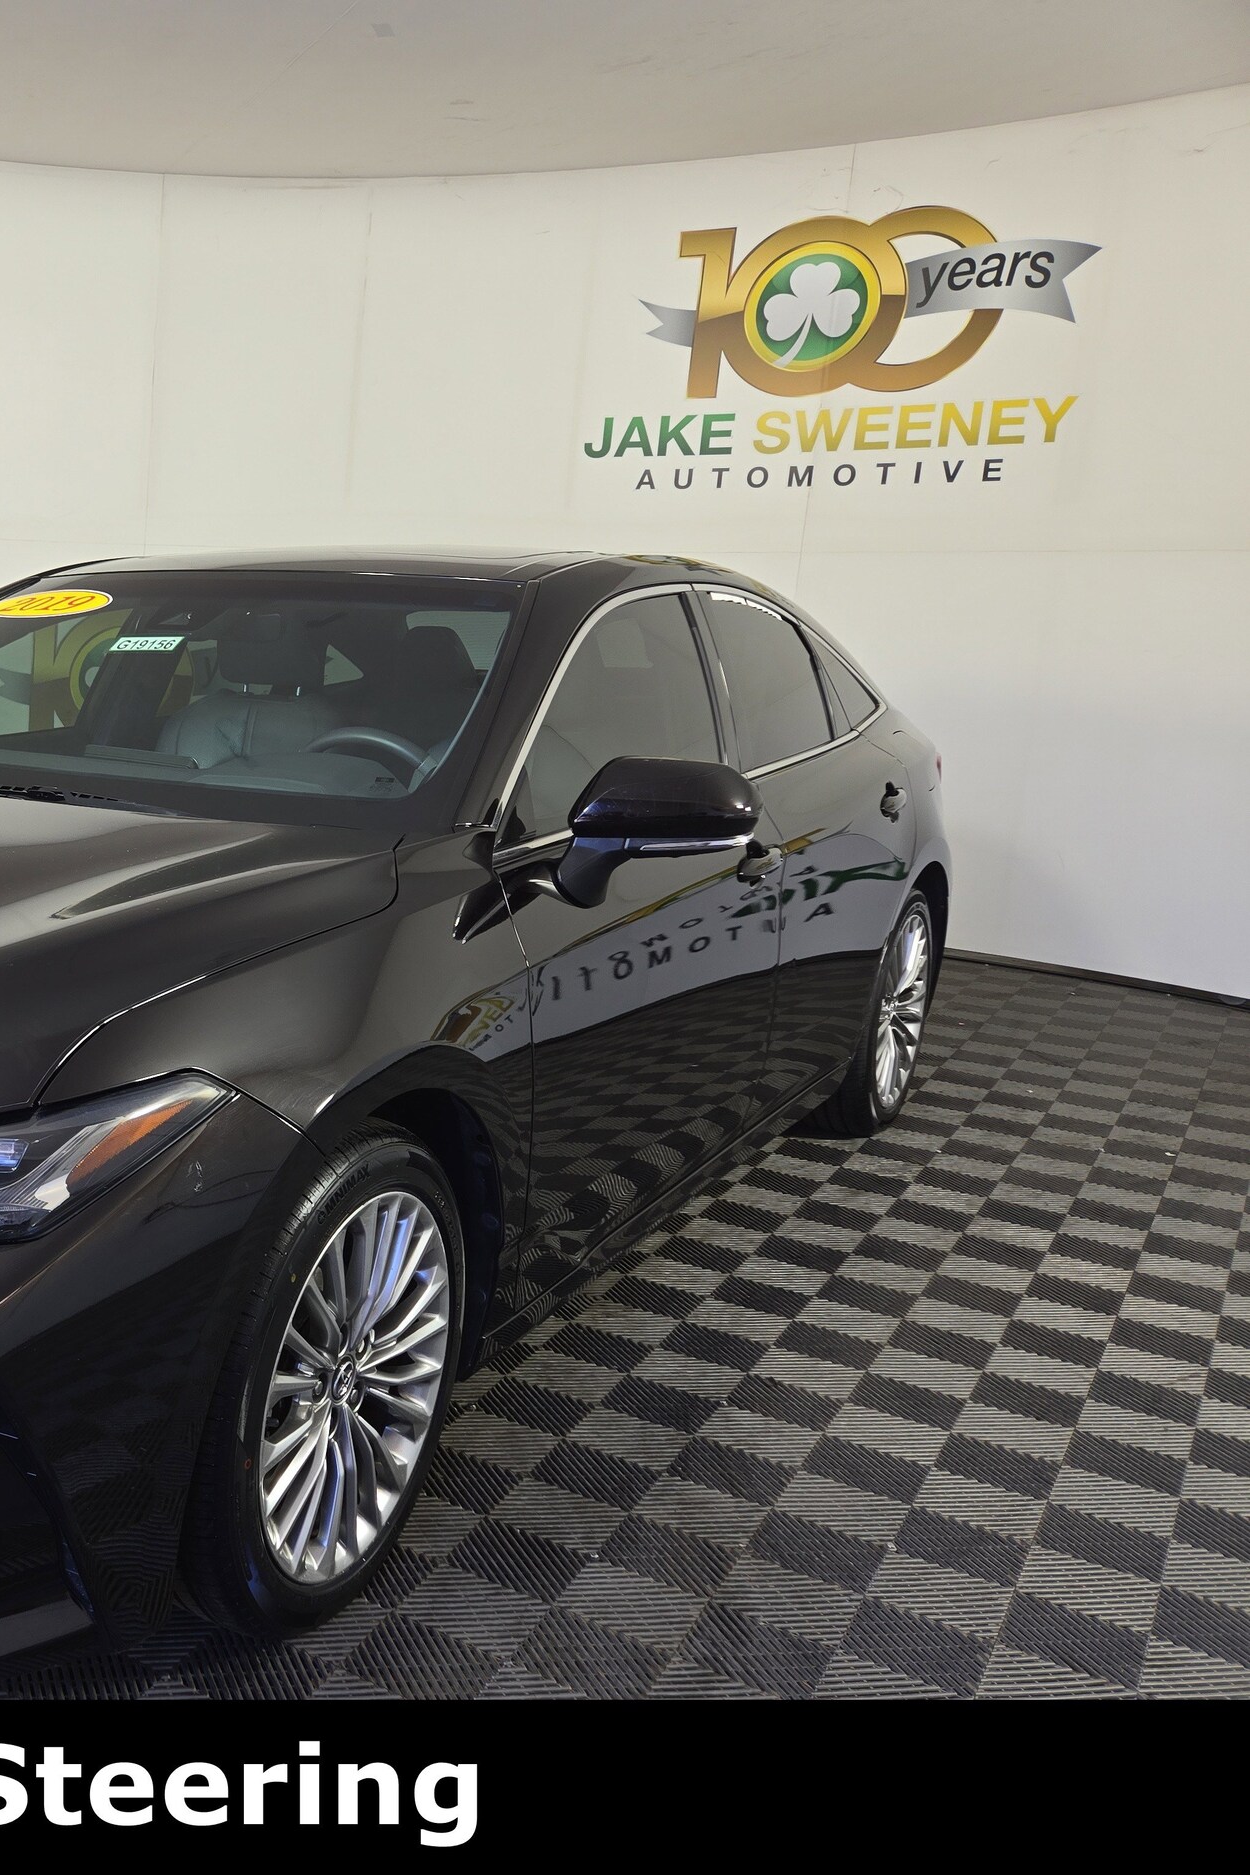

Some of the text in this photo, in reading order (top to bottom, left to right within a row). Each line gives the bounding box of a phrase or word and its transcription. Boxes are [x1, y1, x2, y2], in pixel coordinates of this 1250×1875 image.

[679, 205, 1055, 399] 100 years
[584, 395, 1080, 459] JAKE SWEENEY
[636, 458, 1004, 491] AUTOMOTIVE
[116, 638, 177, 651] G19156
